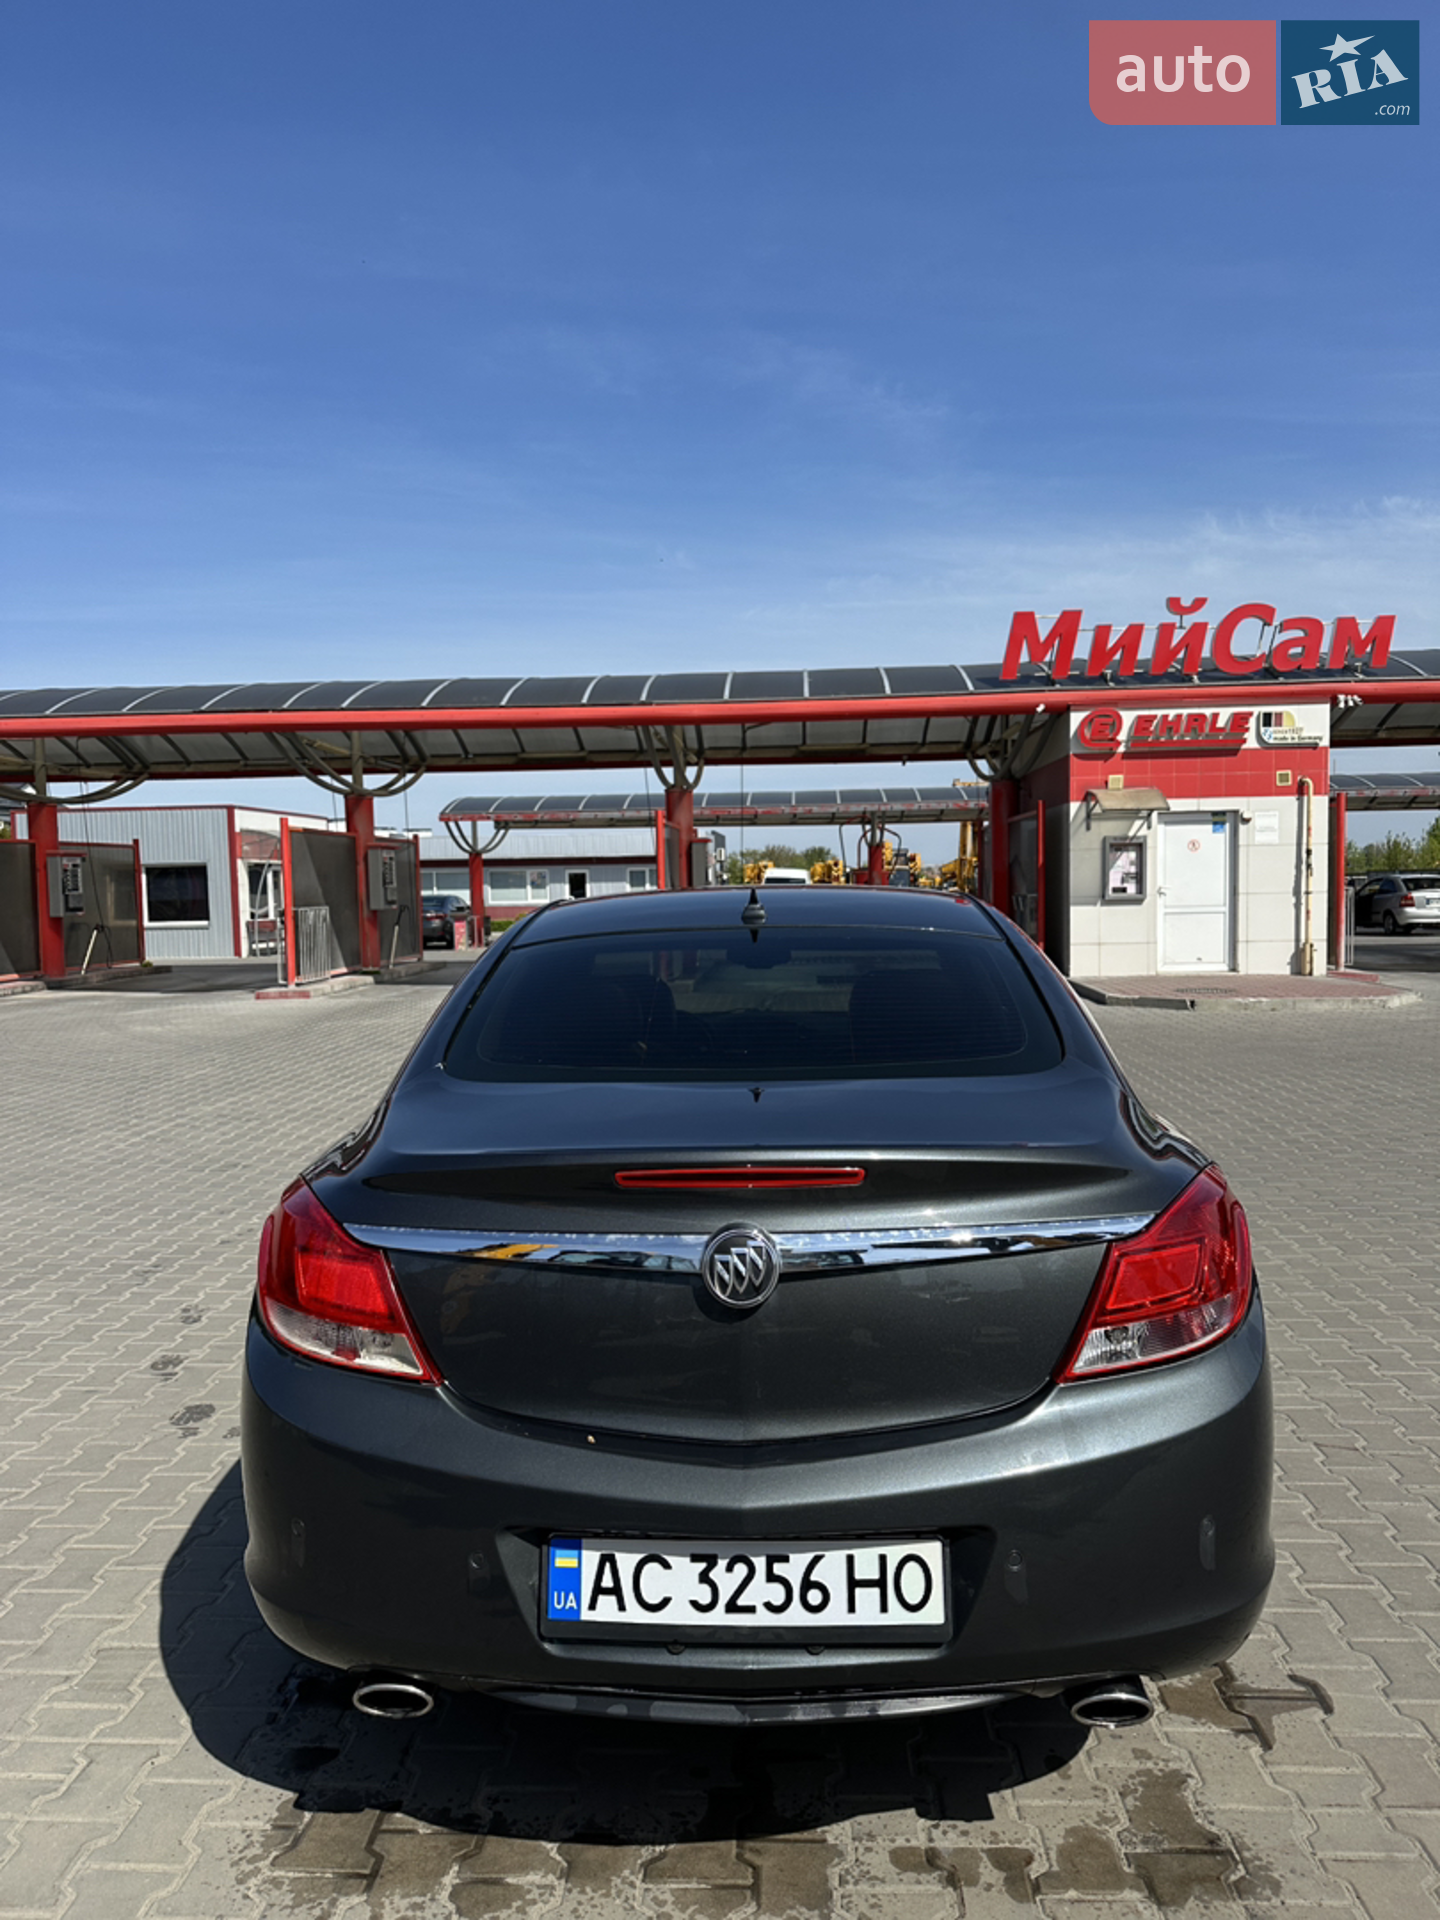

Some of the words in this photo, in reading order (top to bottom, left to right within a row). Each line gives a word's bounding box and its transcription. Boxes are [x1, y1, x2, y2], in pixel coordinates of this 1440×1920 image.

[998, 597, 1397, 681] МийСам
[1133, 712, 1253, 737] EHRLE
[553, 1590, 577, 1610] UA
[588, 1553, 673, 1613] AC
[688, 1553, 831, 1614] 3256
[846, 1553, 933, 1614] HO
